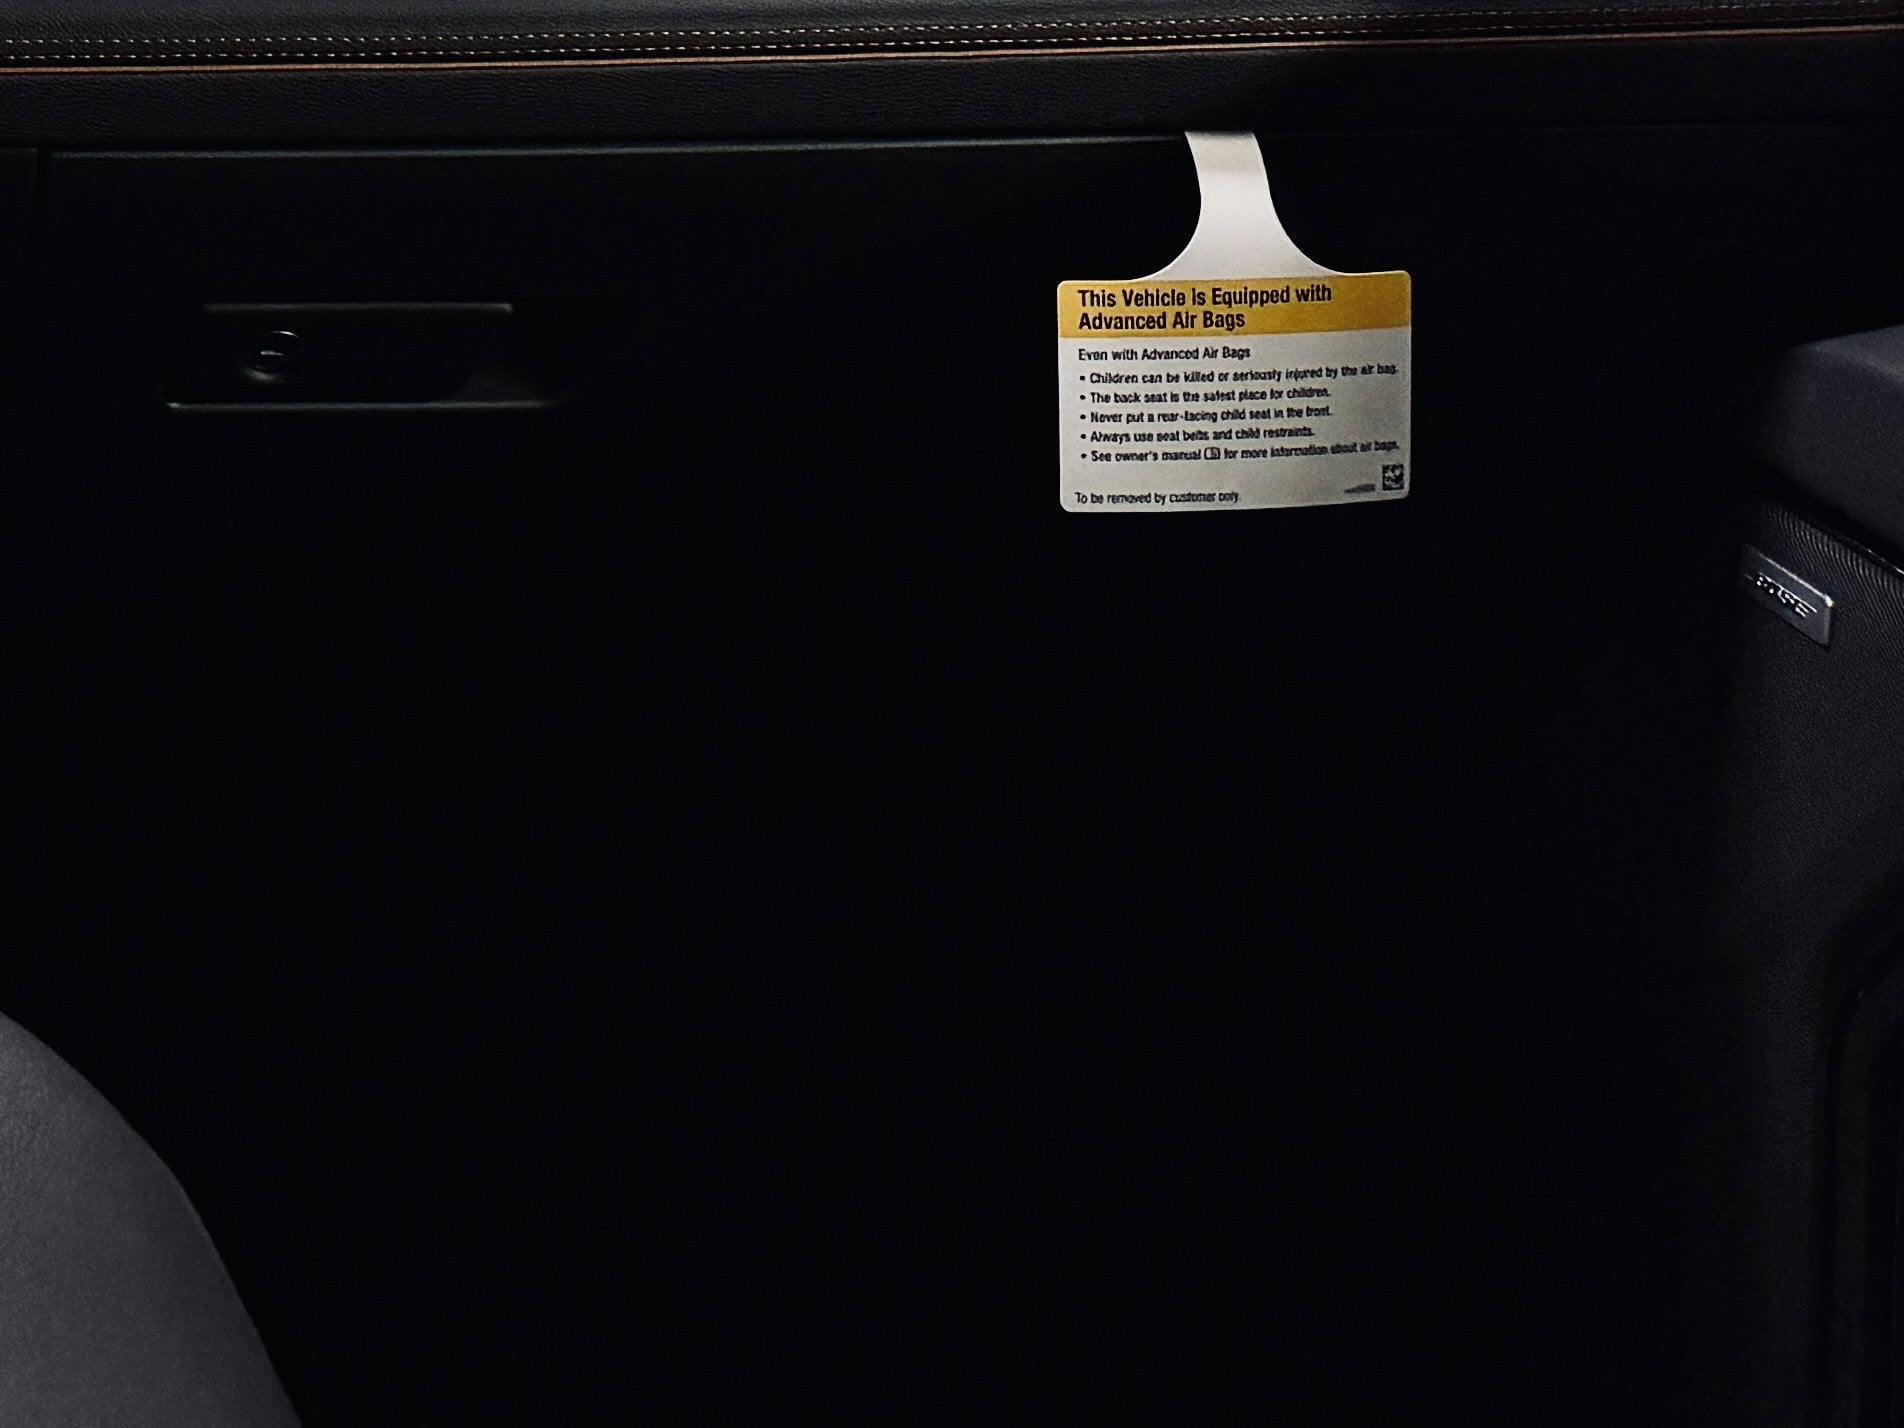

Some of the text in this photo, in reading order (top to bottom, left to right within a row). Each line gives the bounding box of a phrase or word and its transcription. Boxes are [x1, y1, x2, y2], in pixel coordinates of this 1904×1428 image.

[1077, 284, 1333, 308] This Vehicle is Equipped with
[1078, 310, 1246, 332] Advanced Air Bags
[1078, 345, 1251, 361] Even with Advanced Air Bags
[1089, 372, 1139, 384] Children
[1141, 373, 1163, 384] can
[1166, 372, 1180, 384] be
[1183, 370, 1215, 383] killed
[1218, 373, 1230, 383] or
[1232, 368, 1283, 382] seriously
[1285, 366, 1323, 381] injured
[1326, 367, 1339, 380] by
[1341, 365, 1358, 377] the
[1360, 364, 1375, 376] air
[1090, 392, 1111, 403] The
[1113, 392, 1142, 404] back
[1144, 391, 1168, 403] seat
[1170, 391, 1180, 402] is
[1182, 390, 1200, 402] the
[1203, 390, 1236, 402] safest
[1238, 388, 1268, 403] place
[1269, 387, 1284, 399] for
[1090, 411, 1123, 423] Never
[1126, 411, 1145, 425] put
[1147, 413, 1155, 423] a
[1157, 410, 1218, 424] rear-facing
[1220, 408, 1246, 421] child
[1249, 408, 1271, 420] seat
[1273, 407, 1285, 419] in
[1286, 406, 1304, 418] the
[1090, 431, 1131, 445] Always
[1133, 432, 1154, 443] use
[1156, 431, 1181, 443] seat
[1182, 430, 1210, 441] belts
[1212, 429, 1233, 441] and
[1235, 427, 1261, 440] child
[1090, 450, 1112, 462] See
[1114, 450, 1159, 462] owner's
[1161, 448, 1202, 462] manual
[1223, 447, 1239, 460] for
[1240, 448, 1268, 459] more
[1270, 444, 1329, 458] information
[1074, 491, 1088, 504] To
[1090, 492, 1104, 504] be
[1106, 492, 1152, 504] removed
[1154, 493, 1167, 506] by
[1168, 491, 1217, 503] customer
